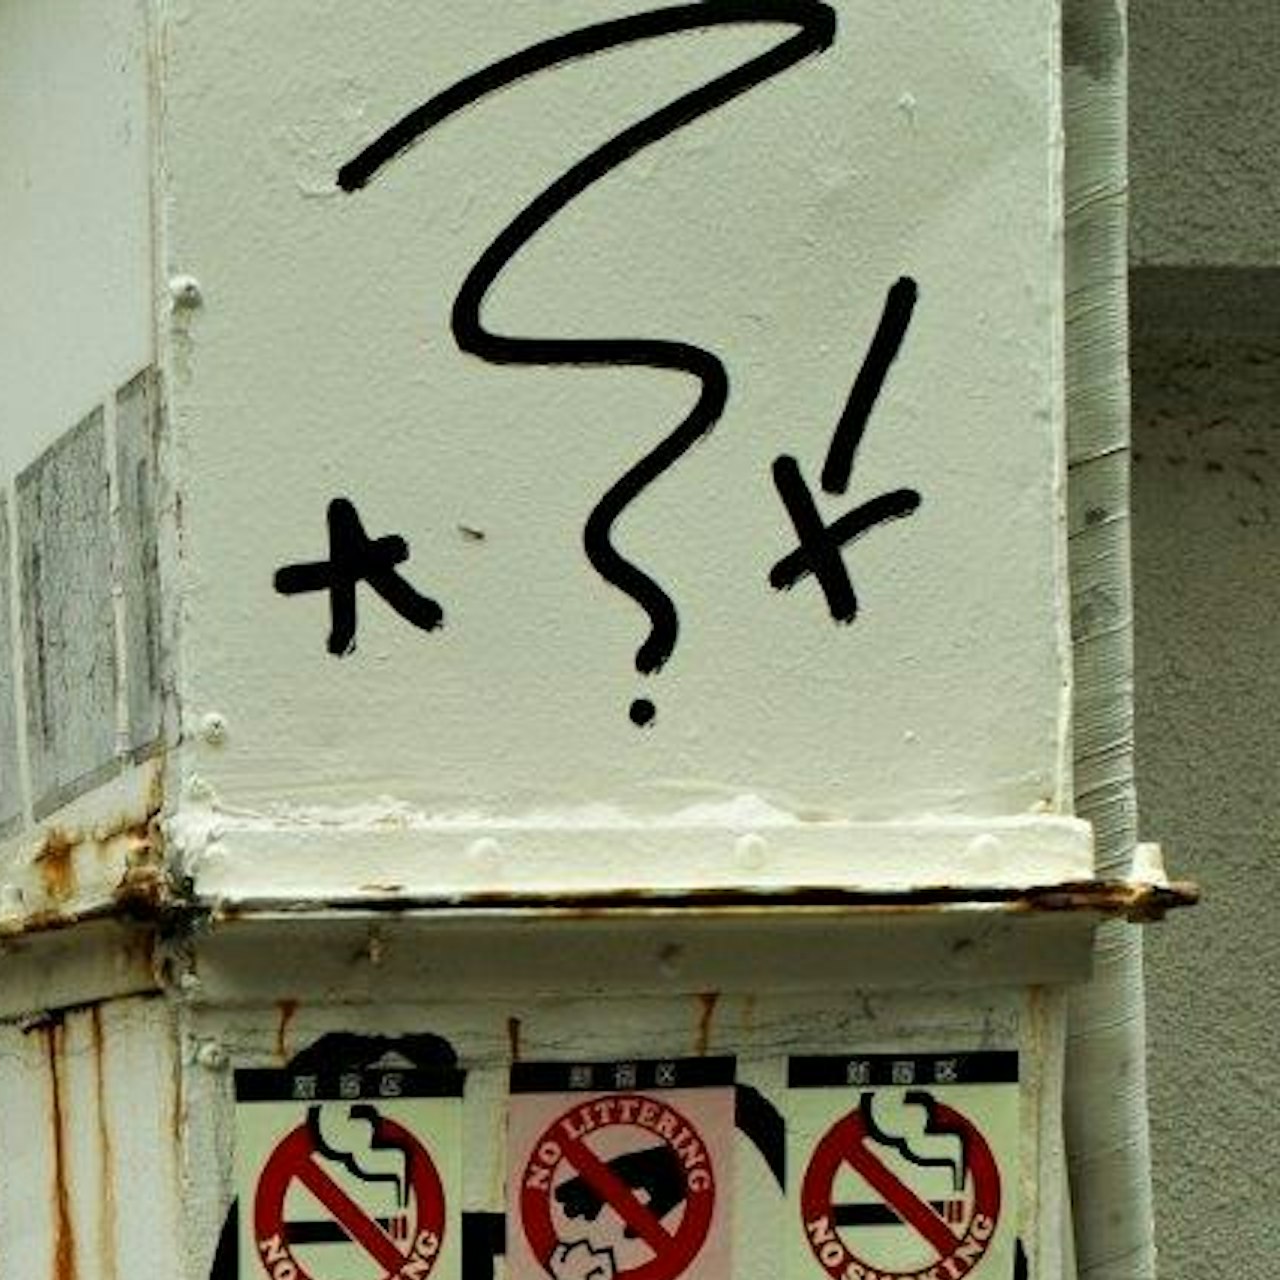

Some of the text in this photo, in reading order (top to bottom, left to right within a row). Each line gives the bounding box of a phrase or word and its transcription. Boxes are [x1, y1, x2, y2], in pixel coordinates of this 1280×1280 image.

[525, 1100, 713, 1192] NO LITTERING
[807, 1214, 845, 1267] NO
